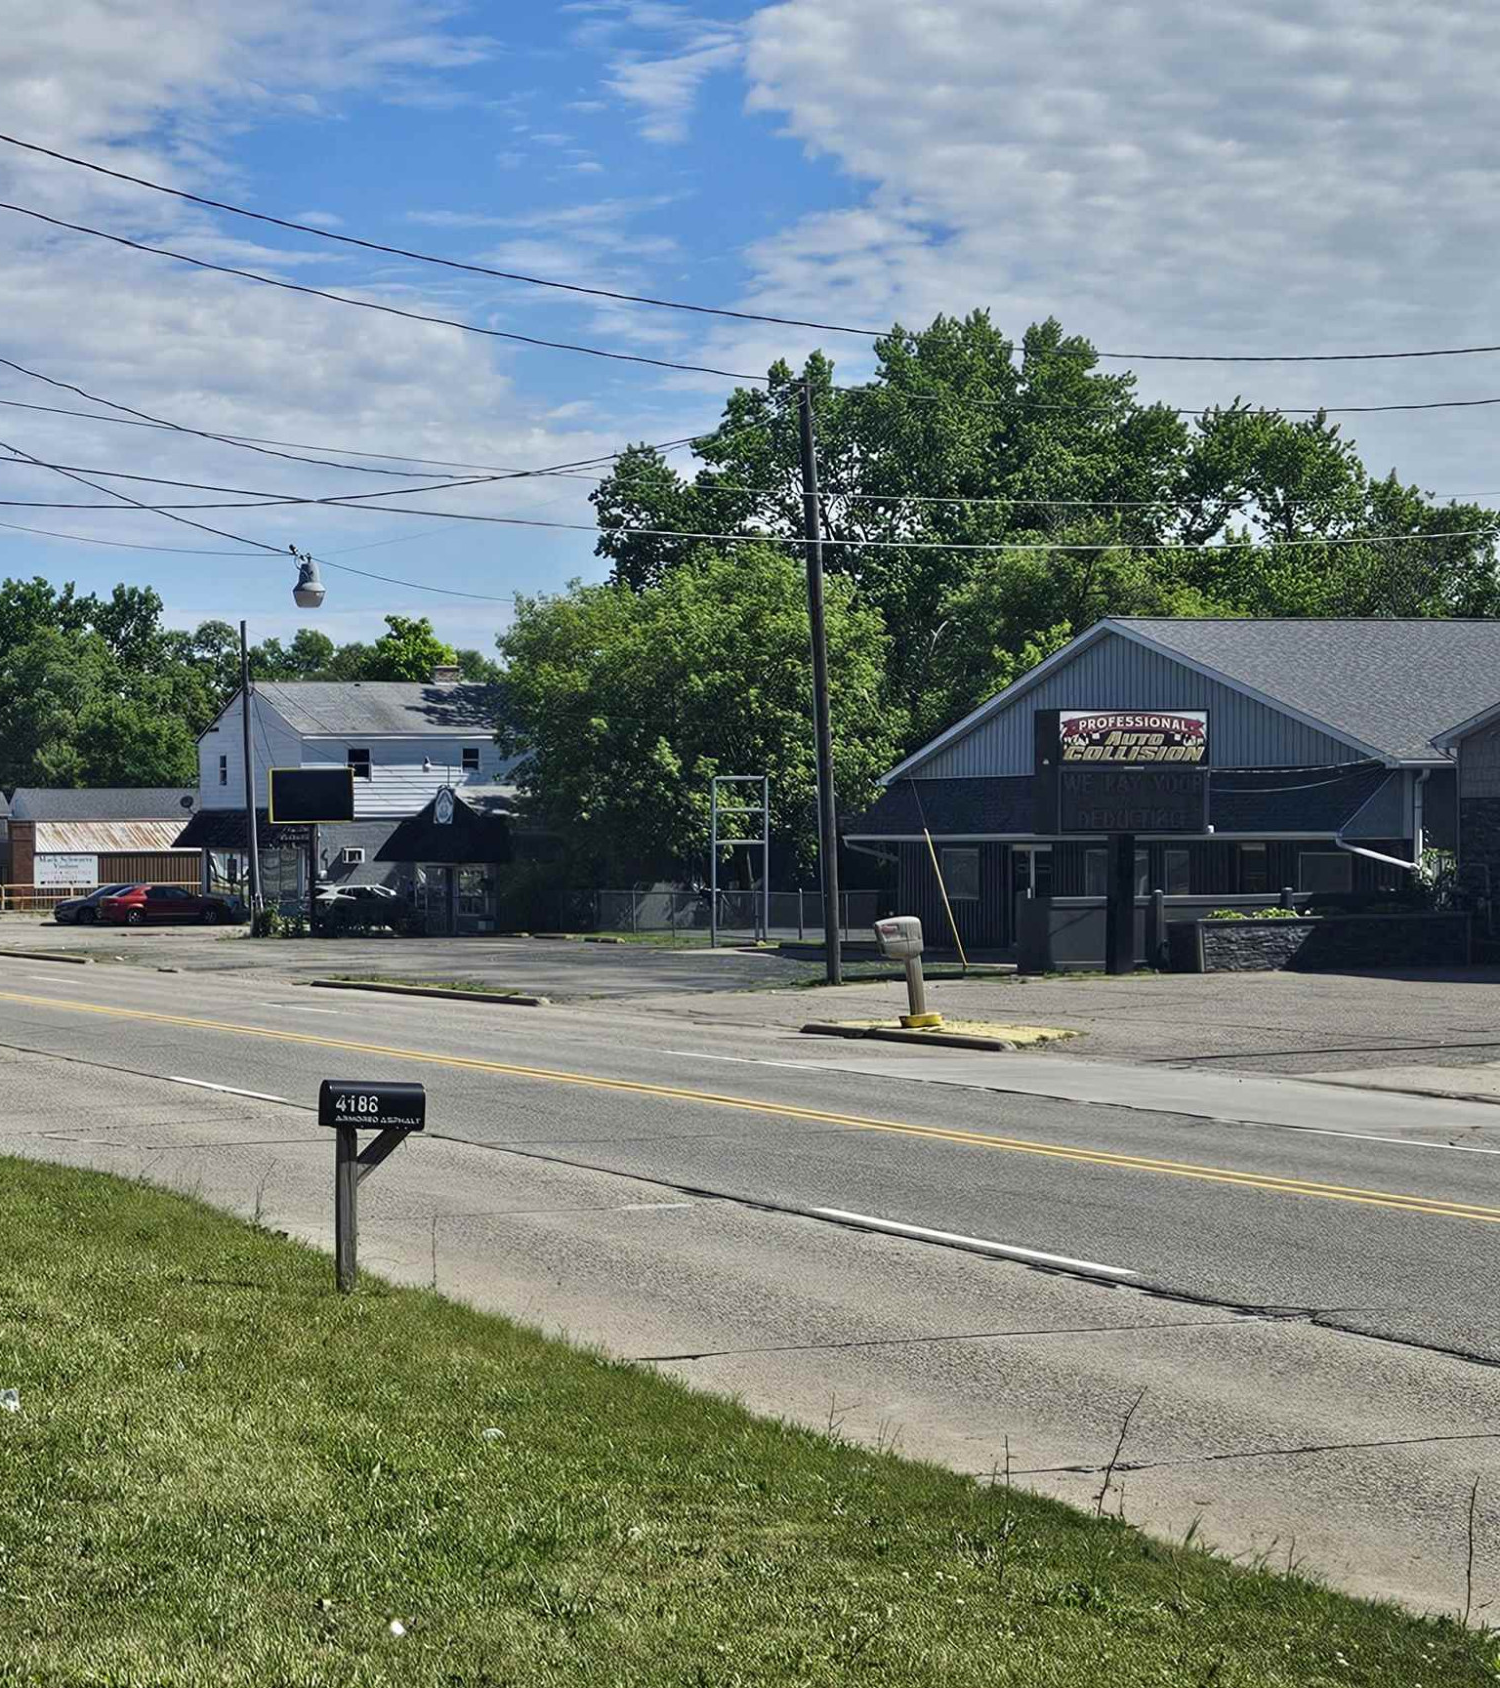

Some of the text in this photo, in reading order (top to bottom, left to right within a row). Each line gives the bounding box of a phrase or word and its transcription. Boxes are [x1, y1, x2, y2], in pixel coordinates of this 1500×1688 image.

[1078, 716, 1188, 731] PROFESSIONAL
[1063, 746, 1206, 761] COLLISION
[336, 1094, 379, 1113] 4186
